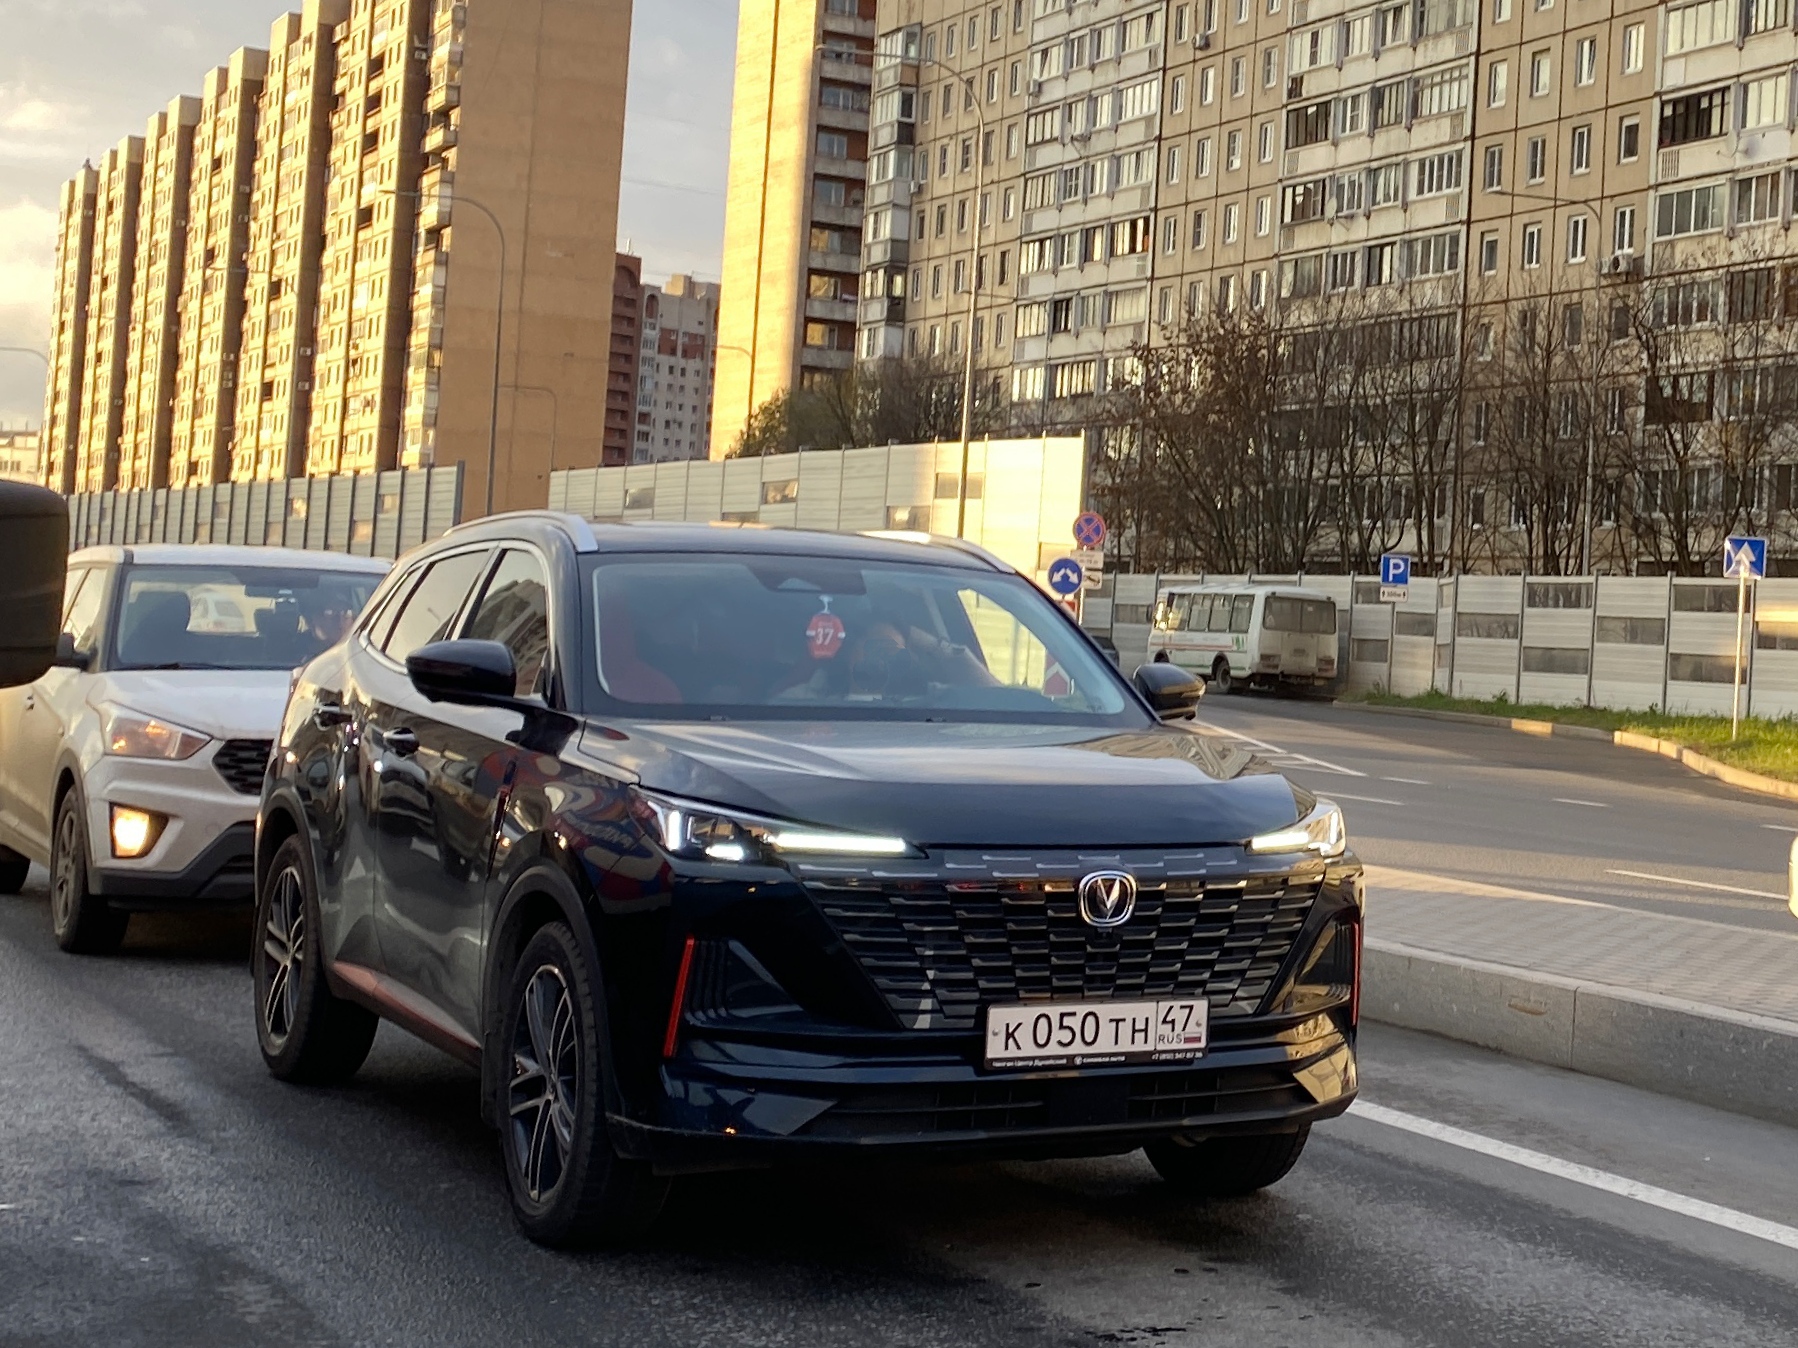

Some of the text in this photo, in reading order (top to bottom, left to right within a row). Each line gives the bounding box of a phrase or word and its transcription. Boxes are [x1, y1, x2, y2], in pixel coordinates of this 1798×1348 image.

[1389, 558, 1405, 582] P
[1004, 1005, 1194, 1051] К 050 ТН 47
[1158, 1032, 1183, 1044] RUS
